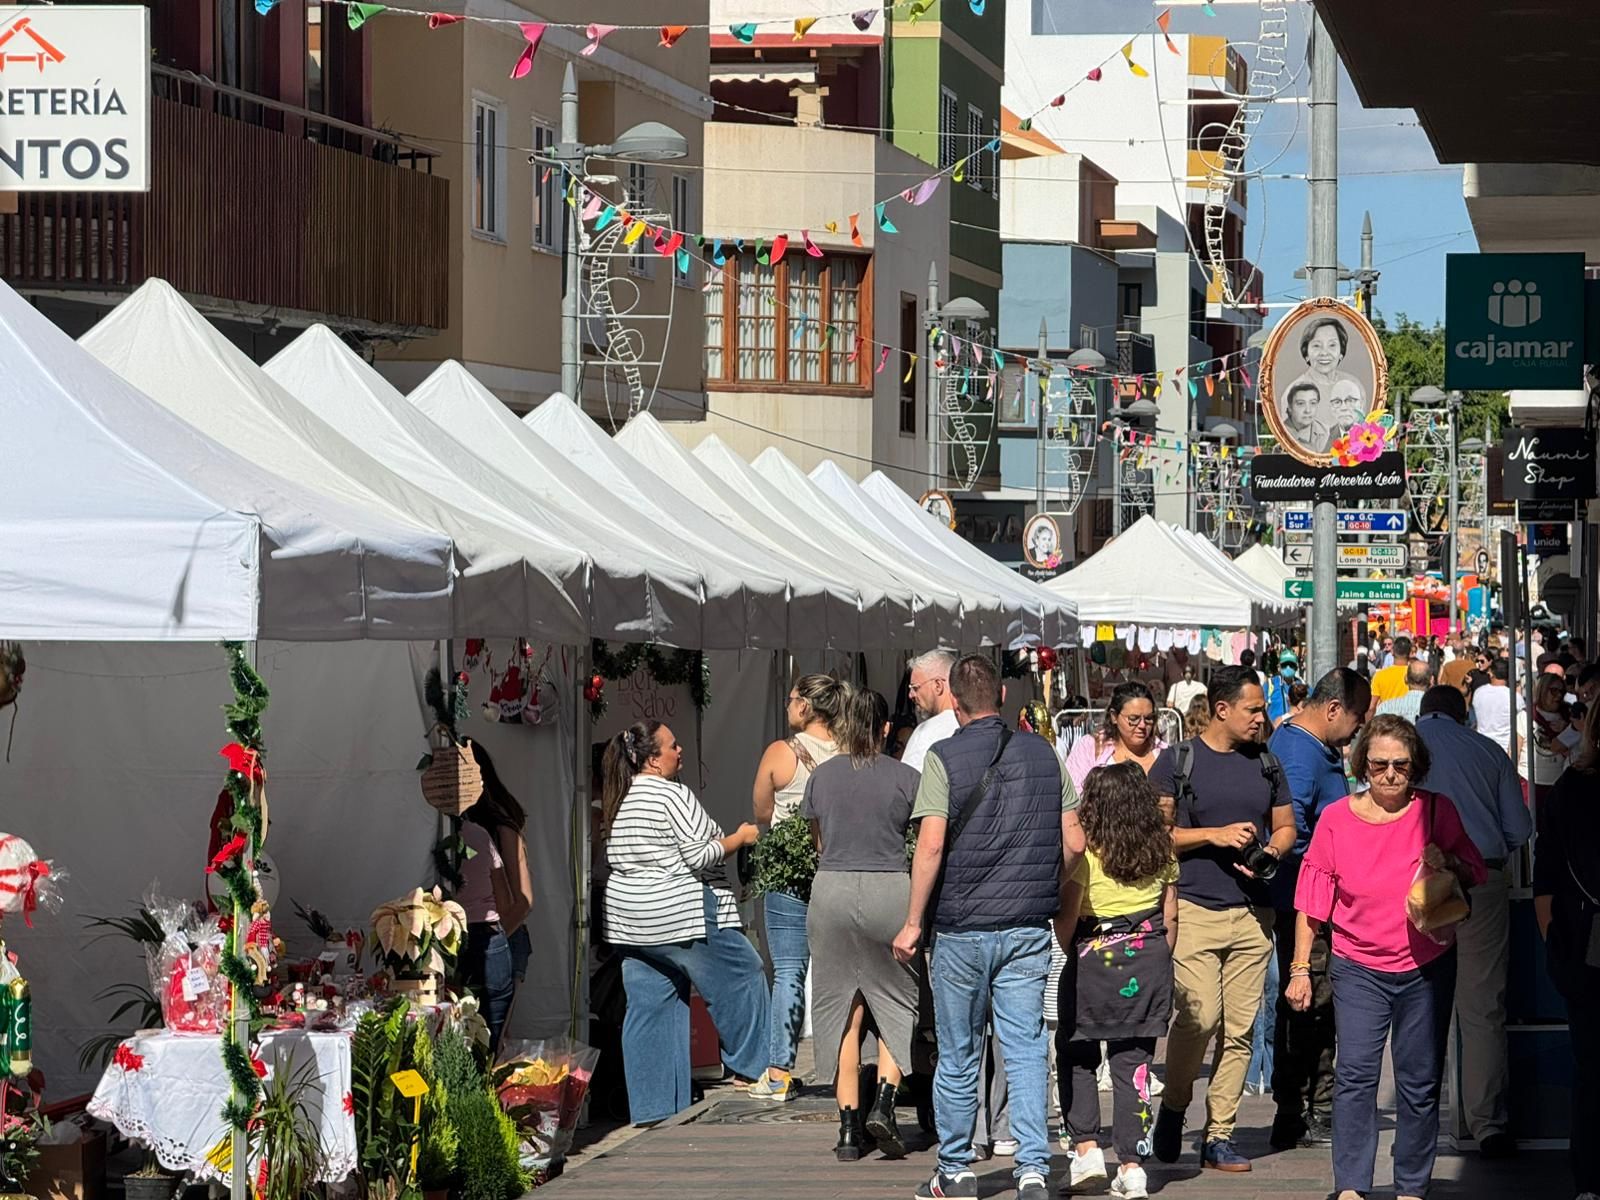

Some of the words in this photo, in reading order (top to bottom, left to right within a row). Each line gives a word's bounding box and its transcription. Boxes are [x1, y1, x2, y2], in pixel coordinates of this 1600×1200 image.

[1455, 333, 1574, 366] cajamar
[1254, 474, 1316, 488] Fundadores
[1319, 472, 1373, 487] Mercería
[1374, 471, 1401, 486] León
[1523, 462, 1575, 490] Shop
[1288, 512, 1304, 521] Las
[1344, 513, 1355, 521] de
[1359, 512, 1376, 521] G.C.
[1288, 520, 1304, 529] Sur
[1533, 537, 1561, 546] unide
[1366, 556, 1401, 564] Magullo
[1340, 590, 1365, 598] Jaime
[1368, 590, 1401, 599] Balmes
